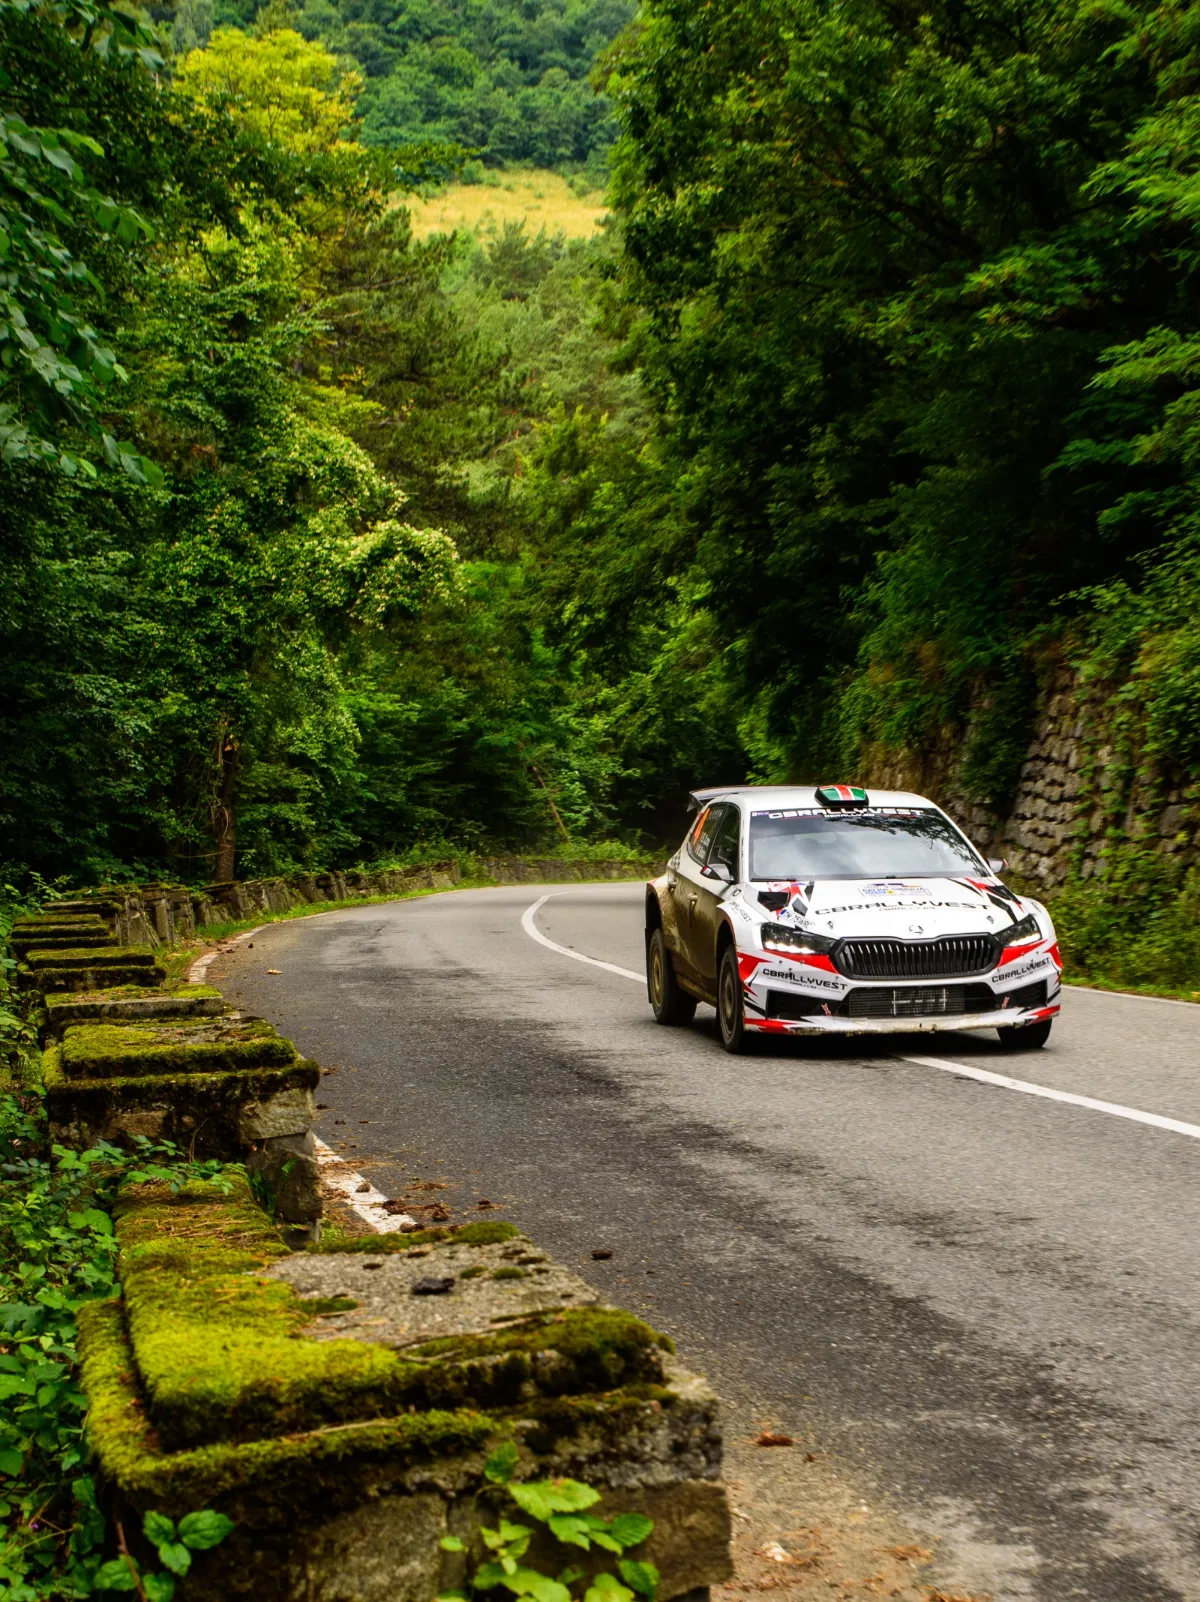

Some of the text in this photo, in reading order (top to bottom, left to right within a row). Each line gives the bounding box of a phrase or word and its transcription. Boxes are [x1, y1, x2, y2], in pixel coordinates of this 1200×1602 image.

[768, 807, 924, 819] CBRALLYVEST
[815, 900, 991, 915] CBRALLYVEST
[762, 968, 848, 990] CBRALLYVEST
[992, 957, 1050, 983] CBRALLYVEST
